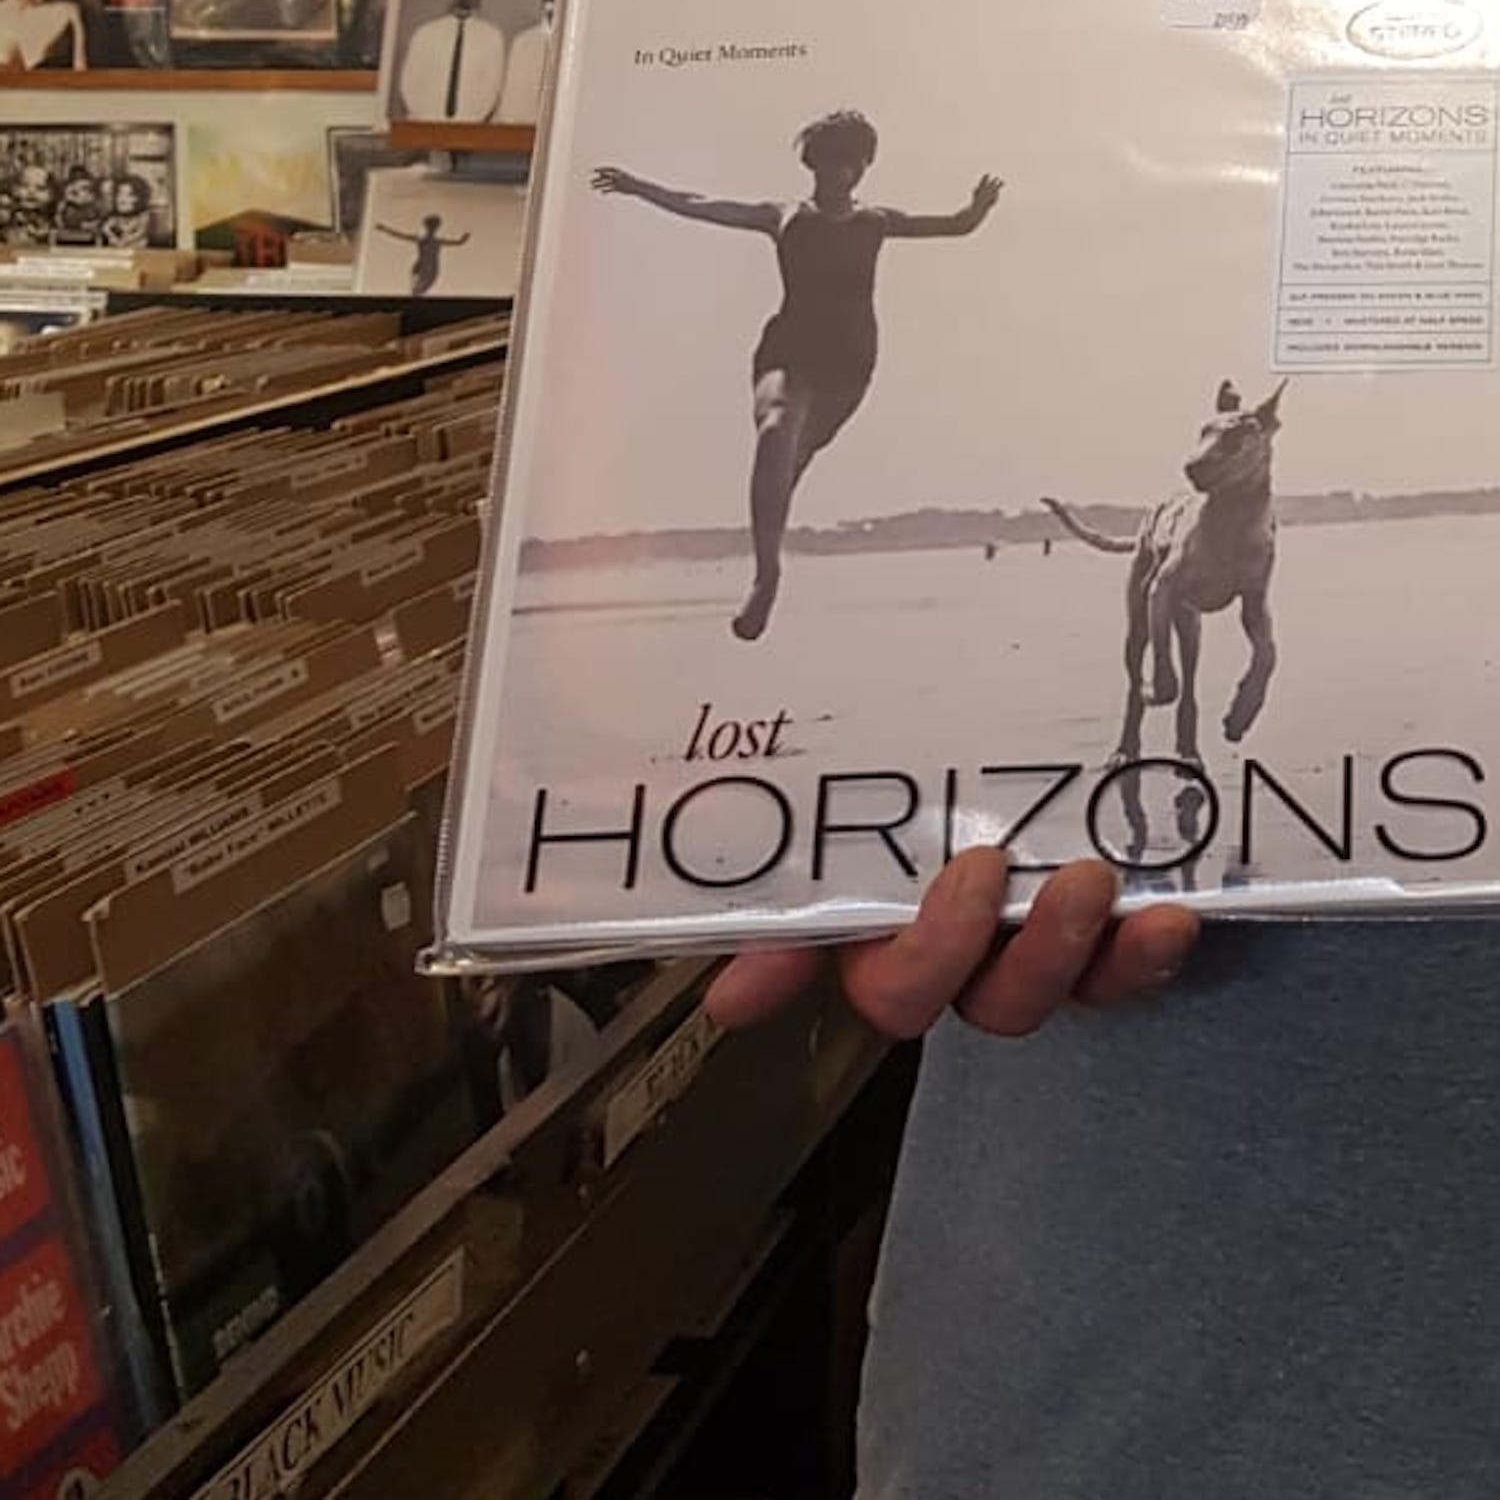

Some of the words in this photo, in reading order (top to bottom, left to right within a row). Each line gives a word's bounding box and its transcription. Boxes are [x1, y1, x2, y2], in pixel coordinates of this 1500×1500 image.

[634, 49, 653, 66] In
[659, 45, 711, 67] Quiet
[718, 43, 808, 63] Moments
[1301, 104, 1489, 128] HORIZONS
[1325, 130, 1381, 146] QUIET
[1389, 128, 1487, 144] MOMENTS
[683, 703, 793, 763] lost
[521, 748, 1488, 894] HORIZONS
